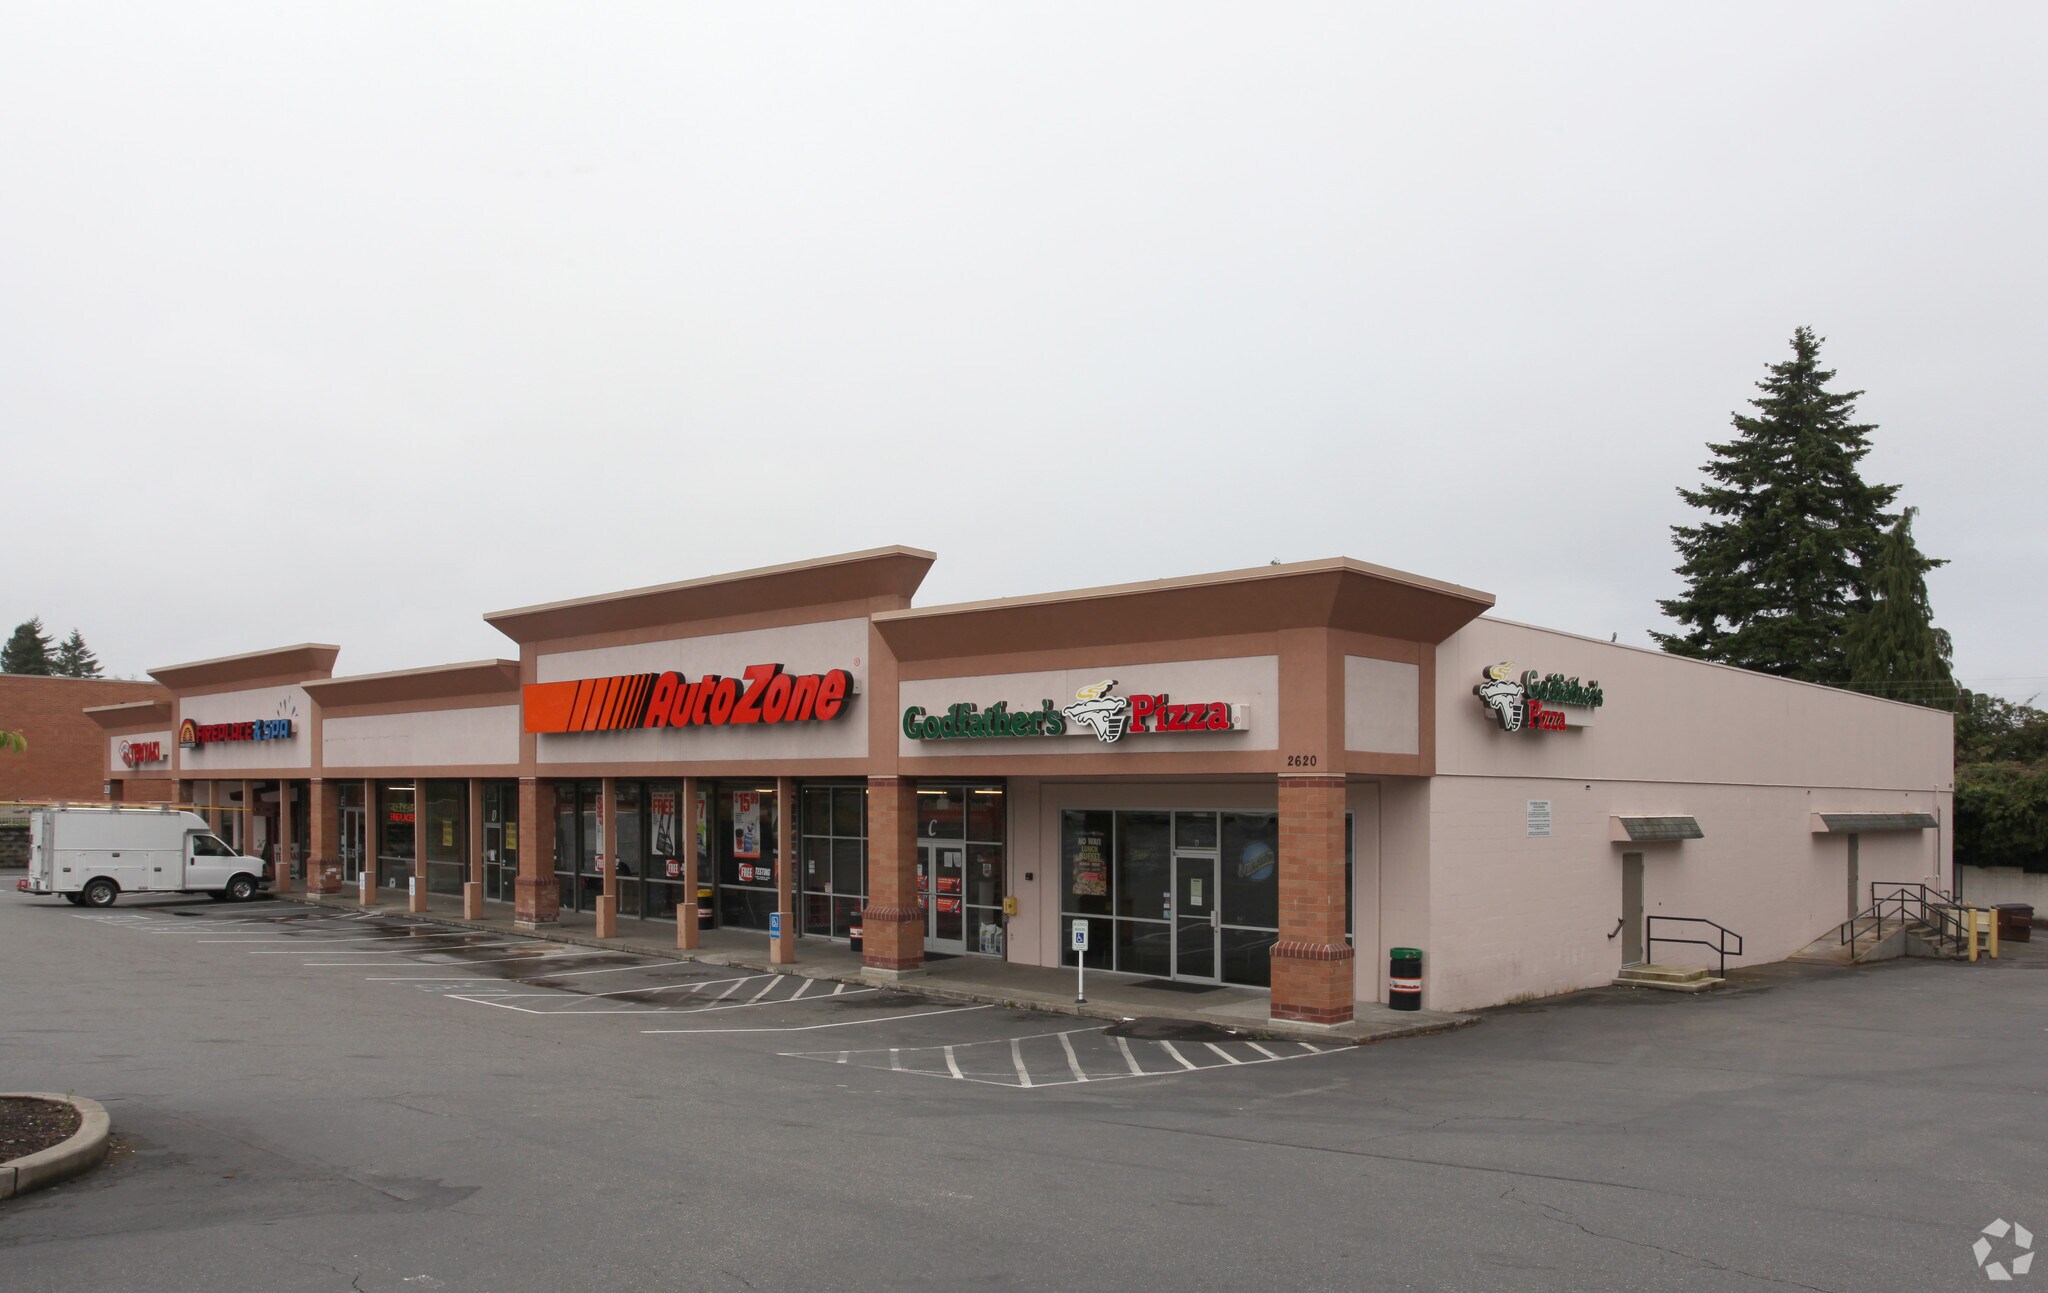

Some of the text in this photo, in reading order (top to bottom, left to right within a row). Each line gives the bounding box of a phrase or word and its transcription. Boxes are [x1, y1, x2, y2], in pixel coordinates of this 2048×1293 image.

[644, 663, 849, 728] AutoZone
[1526, 670, 1604, 707] Godfather's
[902, 694, 1231, 740] Godfather's Pizza
[1528, 699, 1567, 731] Pizza
[195, 719, 290, 743] FIREPLACE & SPA
[1287, 755, 1317, 767] 2620
[653, 799, 674, 816] FREE
[928, 819, 938, 837] C
[1088, 838, 1102, 846] WAIT
[1079, 852, 1101, 861] BUFFET
[668, 863, 679, 874] FREE
[741, 867, 753, 878] FREE
